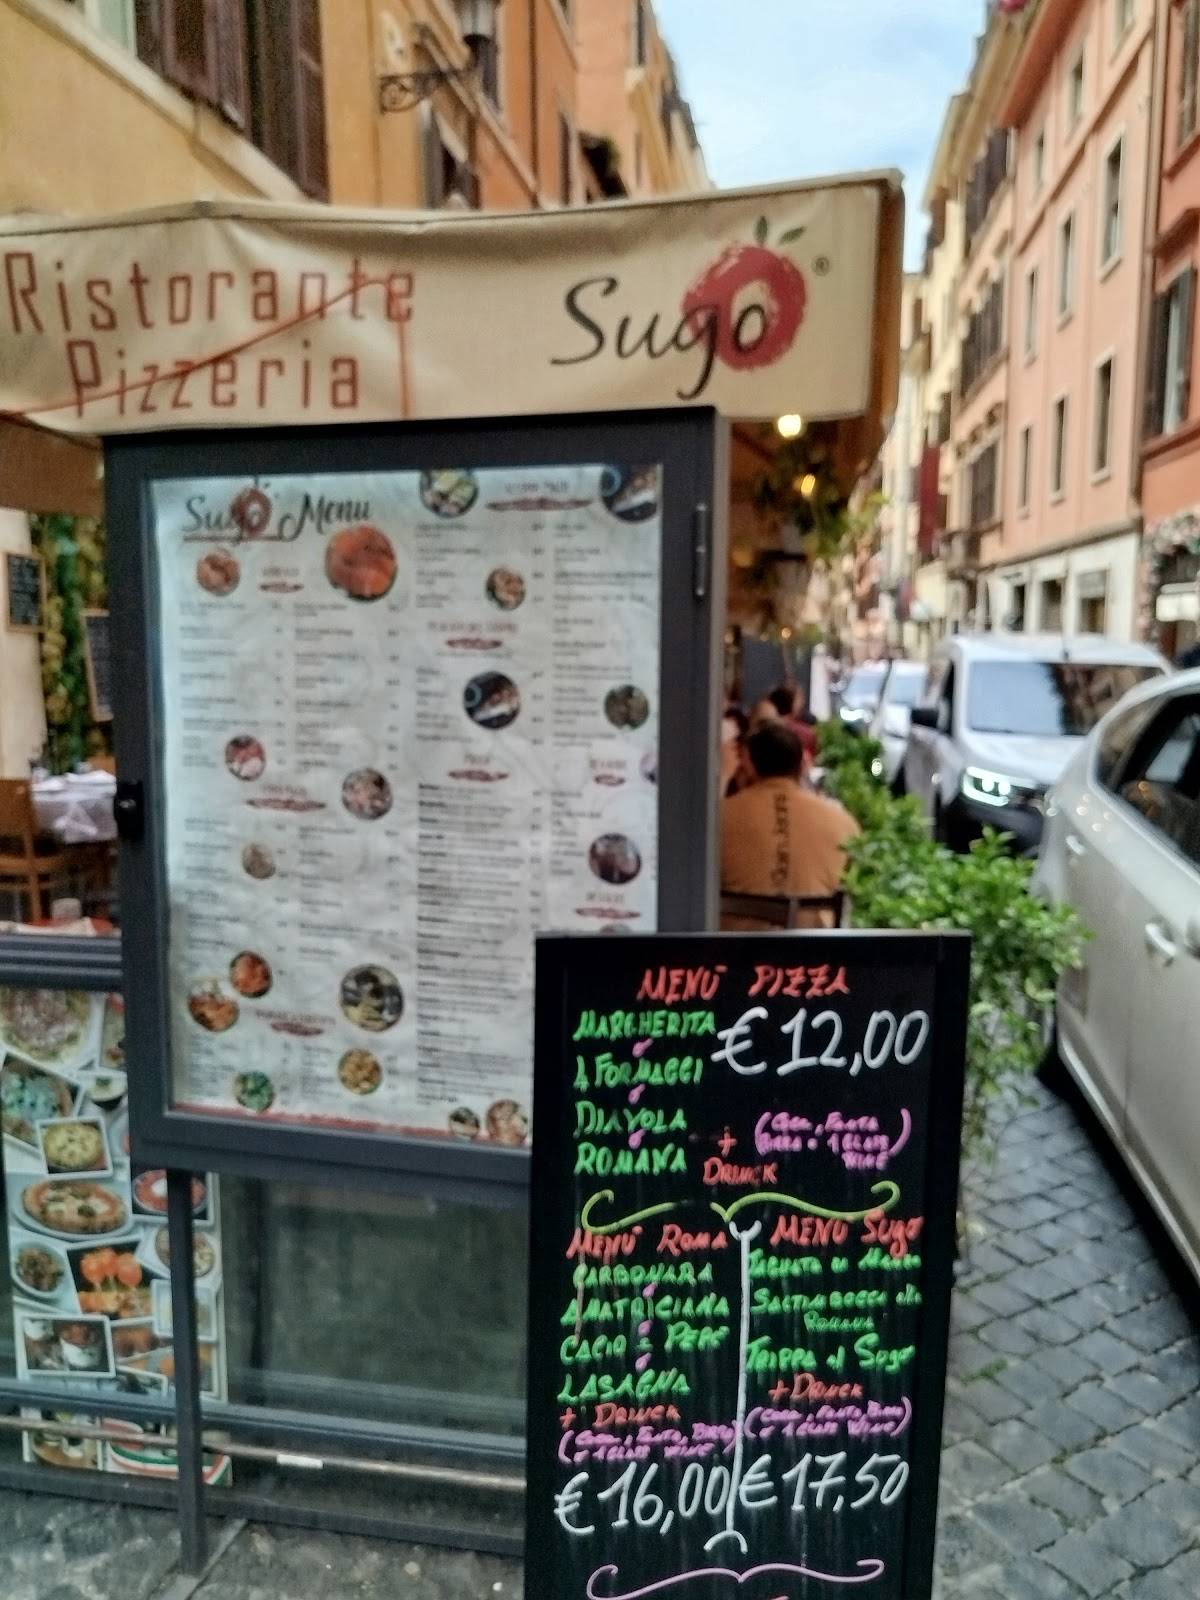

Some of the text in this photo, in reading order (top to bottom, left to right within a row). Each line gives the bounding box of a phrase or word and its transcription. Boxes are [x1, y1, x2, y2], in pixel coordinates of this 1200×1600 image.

[4, 251, 414, 334] Ristorante
[550, 276, 768, 401] Sugo
[67, 339, 360, 416] Pizzeria
[278, 492, 370, 541] Menu
[748, 964, 851, 998] PIZZA
[572, 1009, 717, 1041] MARGHERITA
[711, 1006, 930, 1076] € 12,00
[573, 1100, 688, 1138] DIAVOLA
[574, 1142, 688, 1176] ROMANA
[573, 1262, 713, 1289] CARBONARA
[598, 1461, 730, 1535] 16,00
[782, 1452, 910, 1512] 17,50
